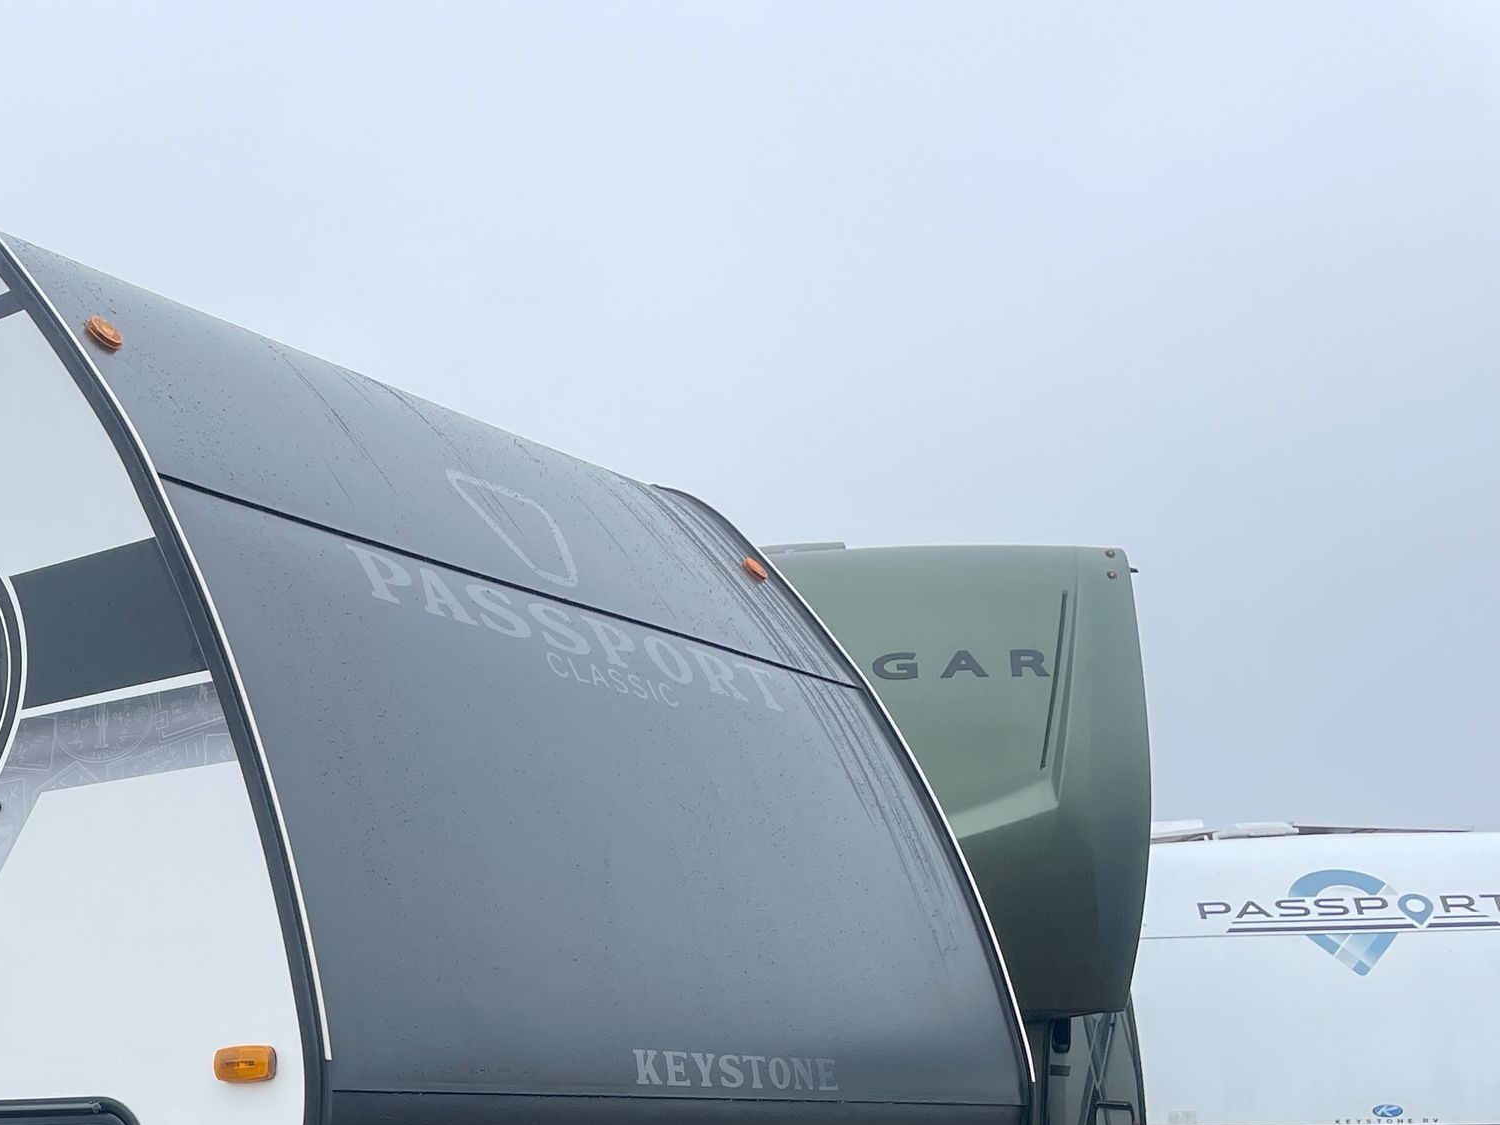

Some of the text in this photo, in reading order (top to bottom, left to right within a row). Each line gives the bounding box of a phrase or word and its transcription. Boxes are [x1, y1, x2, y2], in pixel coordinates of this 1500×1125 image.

[344, 543, 784, 712] PASSPORT
[546, 651, 679, 707] CLASSIC
[872, 649, 1051, 680] GAR
[632, 1049, 839, 1091] KEYSTONE
